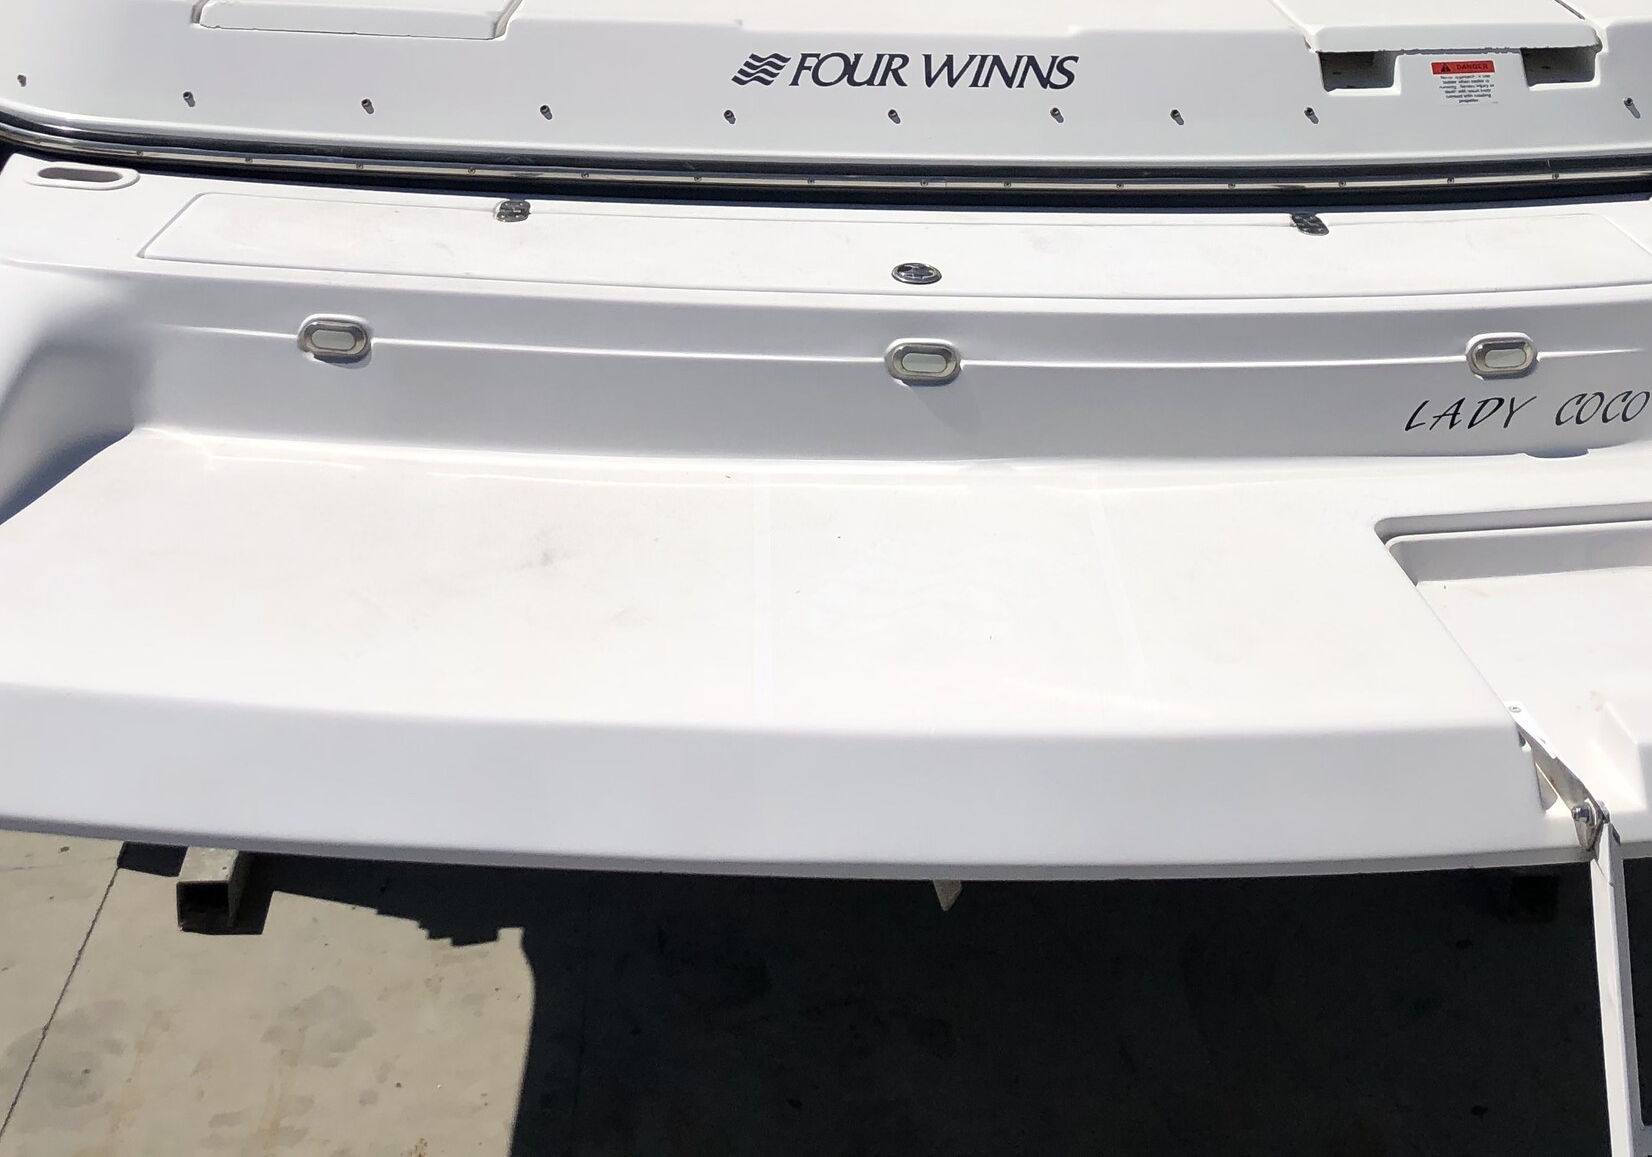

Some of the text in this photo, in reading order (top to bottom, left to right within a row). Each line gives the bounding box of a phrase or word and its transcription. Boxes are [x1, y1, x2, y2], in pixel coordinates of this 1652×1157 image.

[788, 52, 1080, 90] FOUR WINNS
[1455, 63, 1489, 71] DANGER
[1405, 390, 1651, 432] LADY COCO
